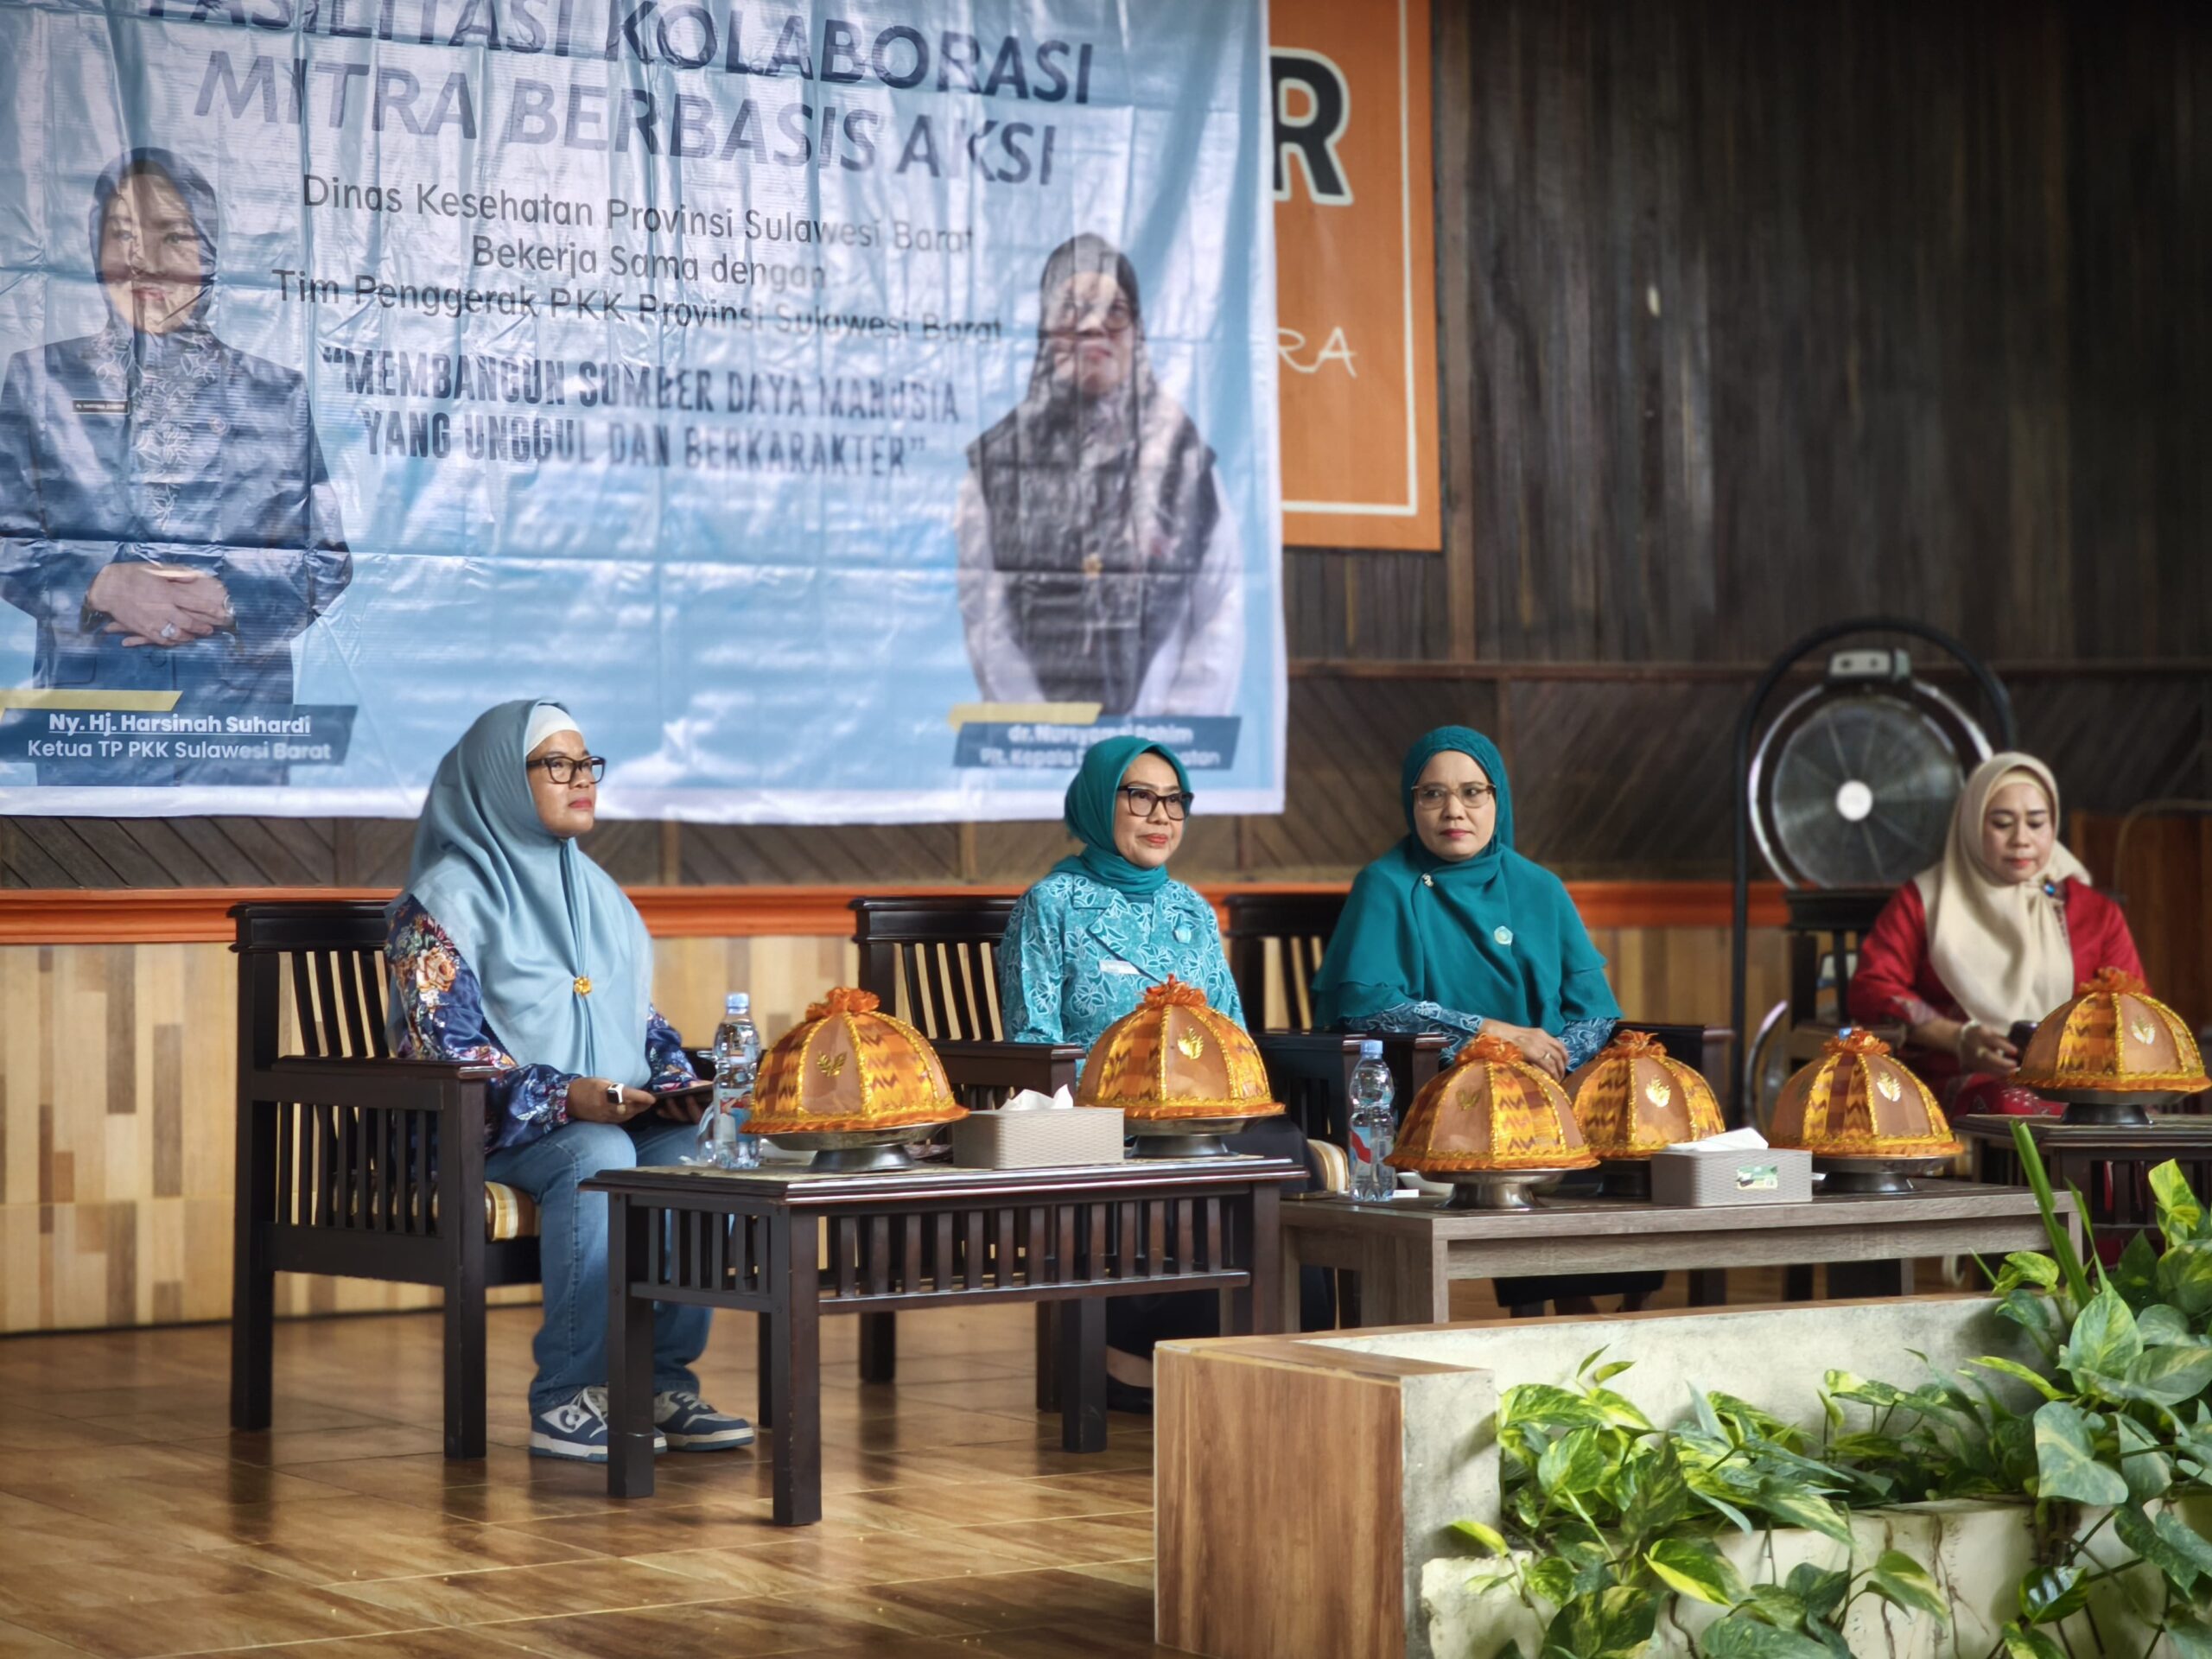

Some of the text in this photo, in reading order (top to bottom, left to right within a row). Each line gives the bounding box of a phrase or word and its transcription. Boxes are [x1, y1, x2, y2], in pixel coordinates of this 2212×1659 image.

[149, 0, 1093, 104] ILITASI KOLABORASI
[194, 50, 1056, 186] MITRA BERBASIS AKSI
[303, 174, 974, 253] Dinas Kesehatan Provinsi Sulawesi Barat
[472, 234, 827, 294] Bekerja Sama dengan
[271, 268, 1002, 344] Tim Penggerak PKK Provinsi Sulawesi Barat
[578, 360, 715, 412] SUMBER
[726, 370, 806, 417] DAYA
[359, 410, 451, 459] YANG
[463, 412, 594, 466] UNGGUL
[611, 423, 671, 468] DAN
[28, 740, 332, 761] Ketua TP PKK Sulawesi Barat
[48, 713, 311, 736] Ny. Hj. Harsinah Suhardi
